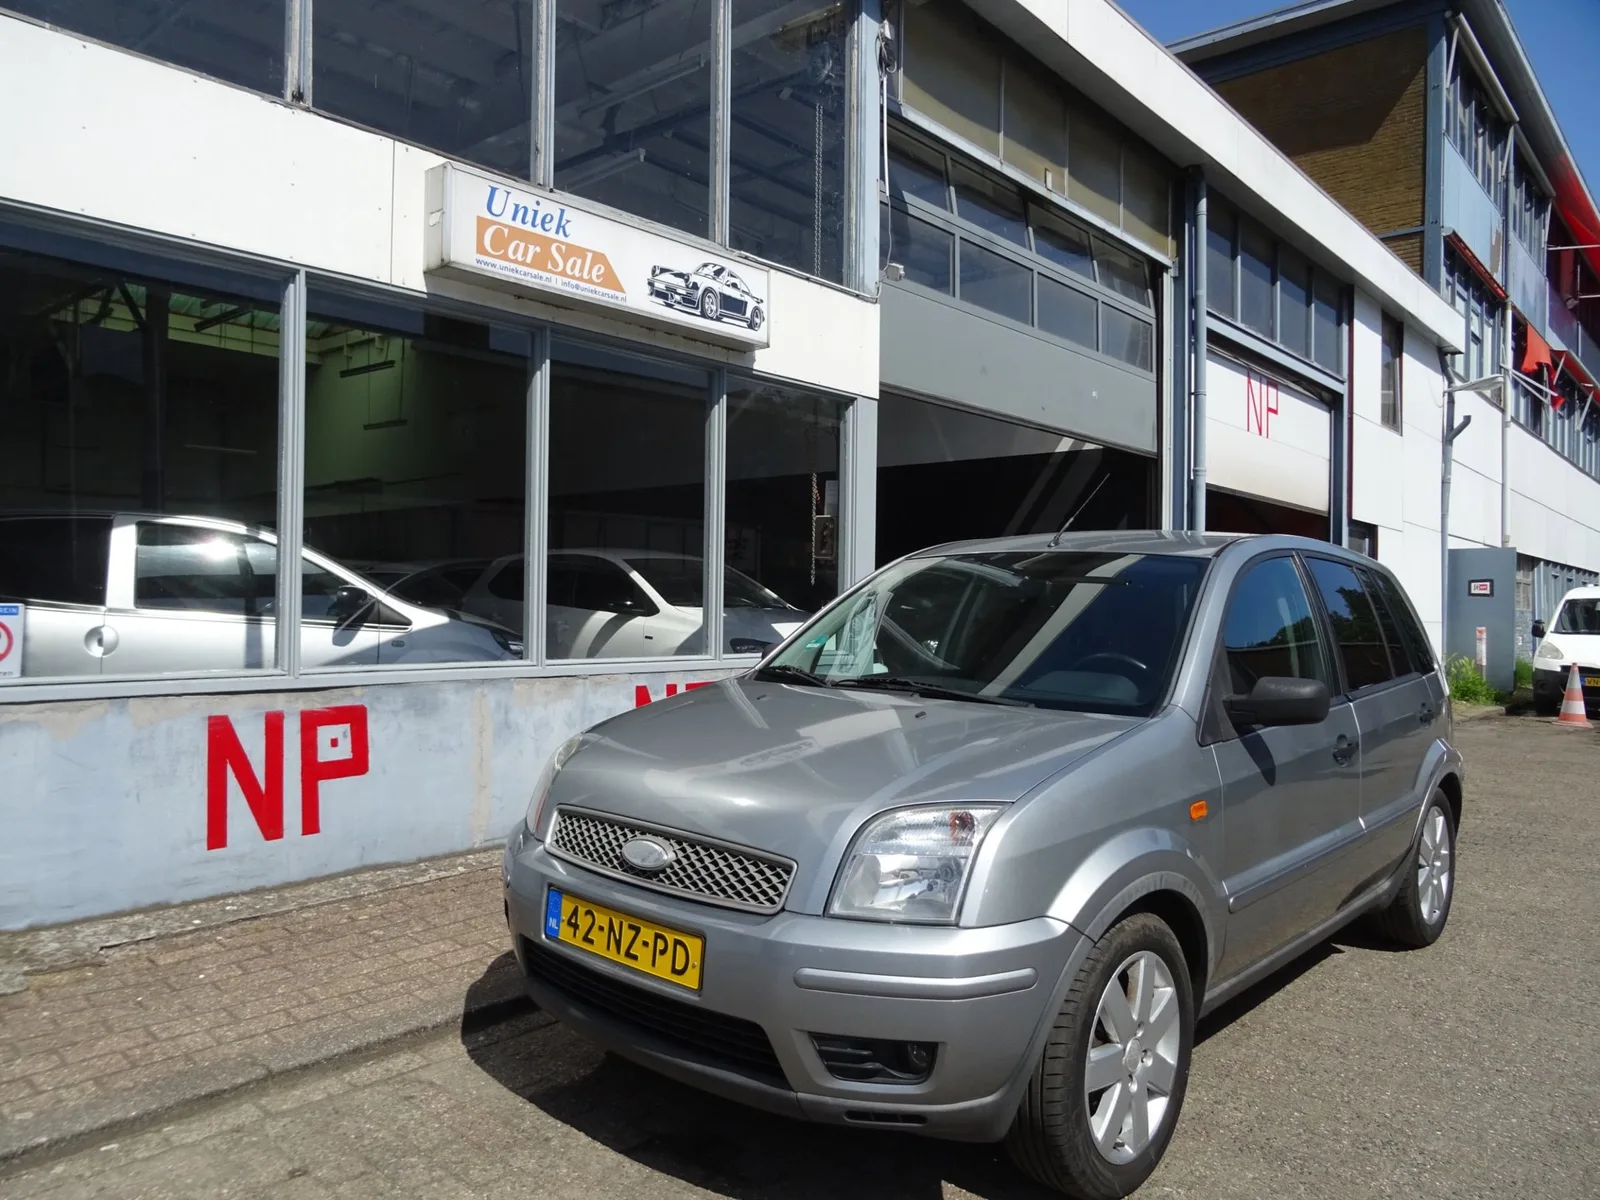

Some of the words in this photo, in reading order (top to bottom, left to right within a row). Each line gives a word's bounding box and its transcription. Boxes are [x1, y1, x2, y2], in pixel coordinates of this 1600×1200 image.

[486, 185, 573, 238] Uniek
[475, 258, 552, 284] www.uniekcarsale.nl
[560, 280, 627, 303] info@uniekcarsale.nl
[483, 224, 541, 264] Car
[547, 242, 606, 283] Sale
[1246, 369, 1279, 439] NP
[206, 704, 370, 851] NP
[549, 917, 559, 930] NL
[566, 905, 691, 976] 42-NZ-PD
